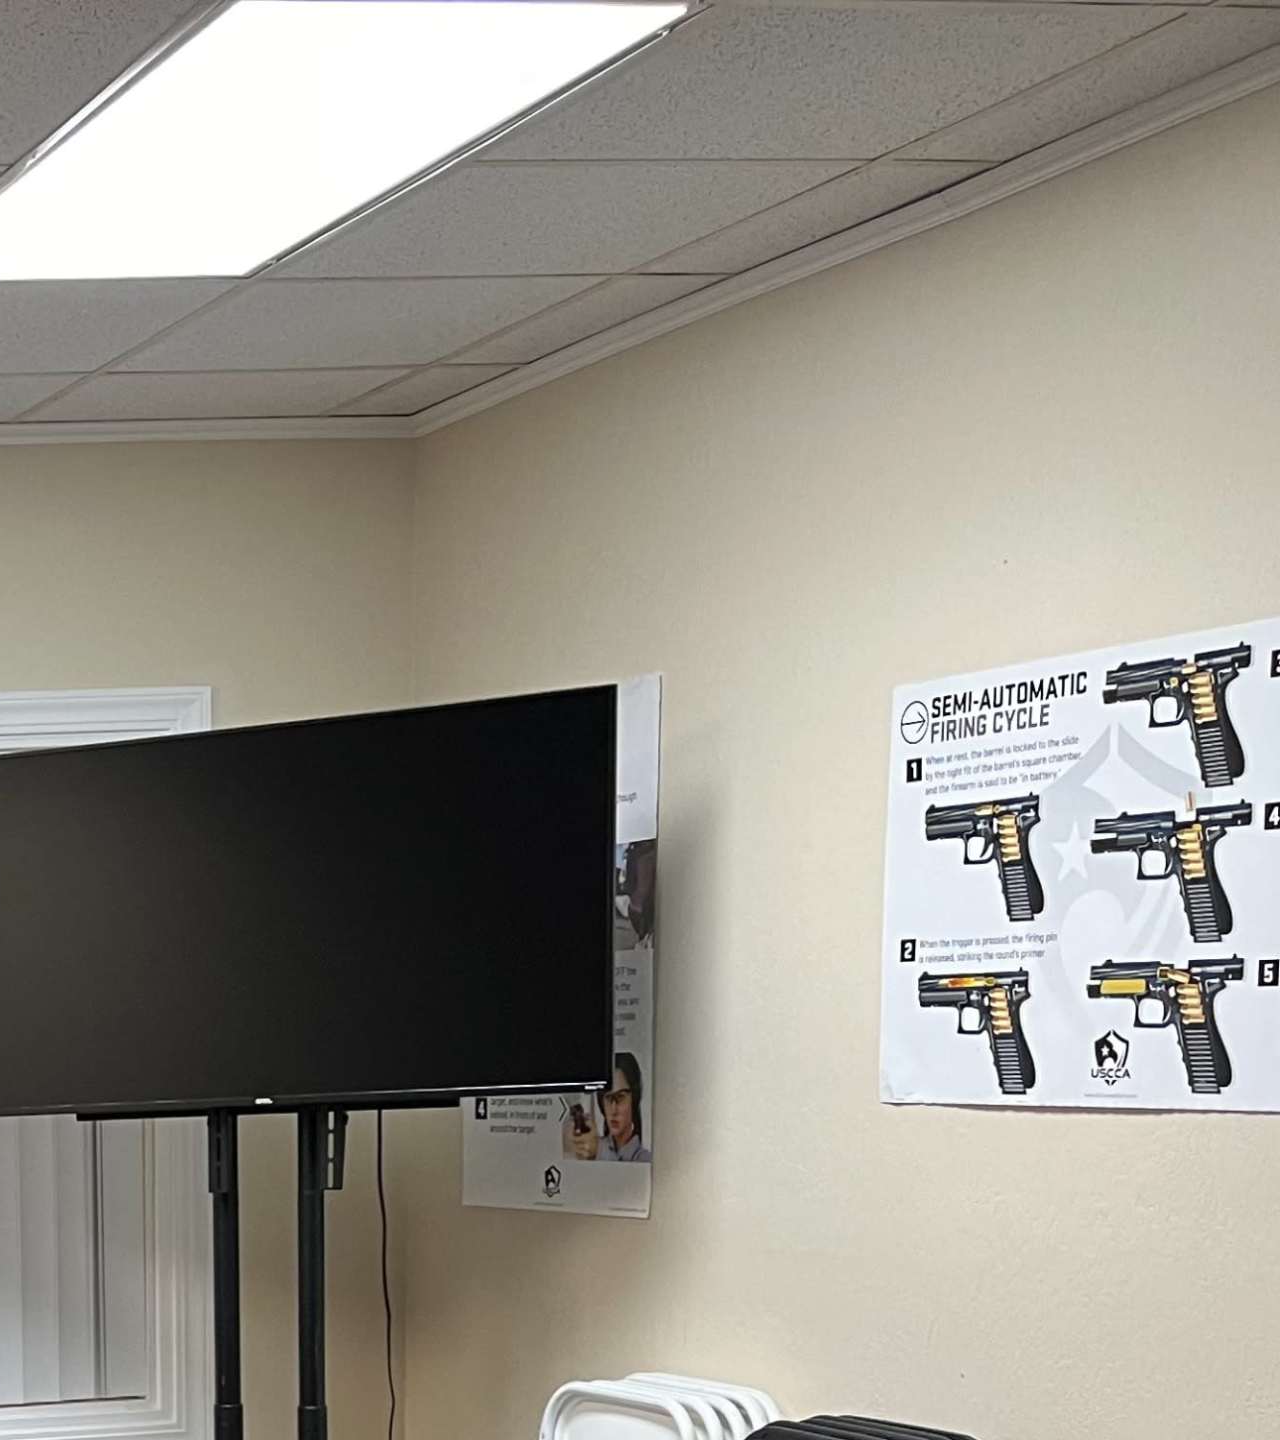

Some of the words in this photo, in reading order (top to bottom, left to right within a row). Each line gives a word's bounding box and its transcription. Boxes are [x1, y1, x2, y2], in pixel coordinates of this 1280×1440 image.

[931, 671, 1088, 719] SEMI-AUTOMATIC
[930, 713, 987, 744] FIRING
[992, 704, 1051, 734] CYCLE
[971, 750, 982, 759] the
[1012, 741, 1037, 752] locked
[1038, 741, 1046, 749] to
[1047, 739, 1060, 748] the
[934, 770, 946, 779] the
[972, 764, 981, 774] of
[982, 763, 993, 772] the
[939, 784, 950, 794] the
[1008, 776, 1018, 784] be
[1011, 935, 1023, 944] the
[1025, 932, 1045, 944] firing
[1091, 1068, 1131, 1079] USCCA
